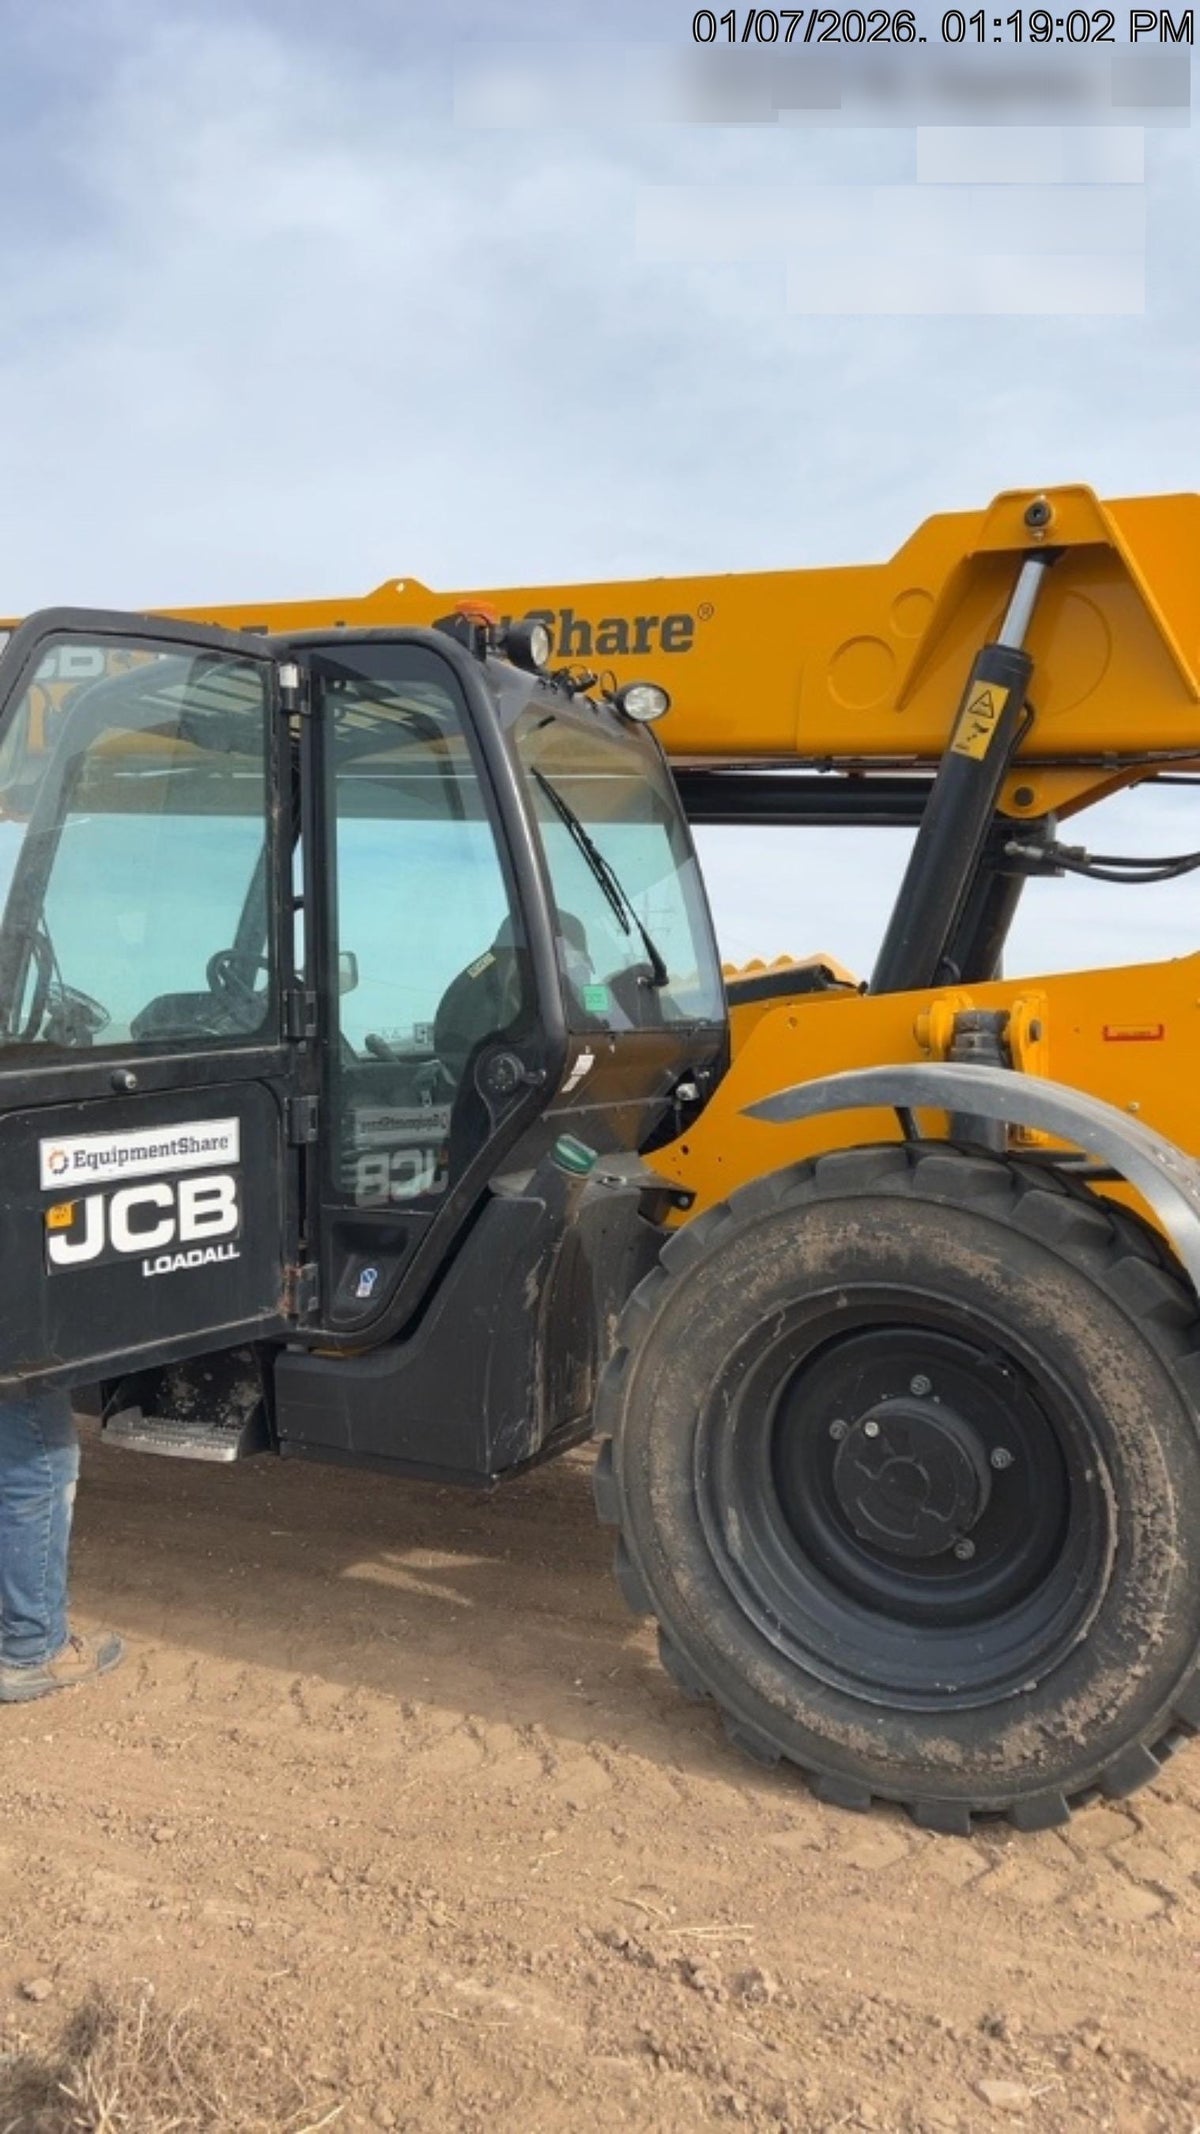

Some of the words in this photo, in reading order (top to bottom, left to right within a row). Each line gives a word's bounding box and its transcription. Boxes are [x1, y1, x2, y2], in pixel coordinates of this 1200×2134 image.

[73, 1136, 229, 1170] EquipmentShare
[49, 1175, 239, 1264] JCB
[142, 1243, 240, 1276] LOADALL
